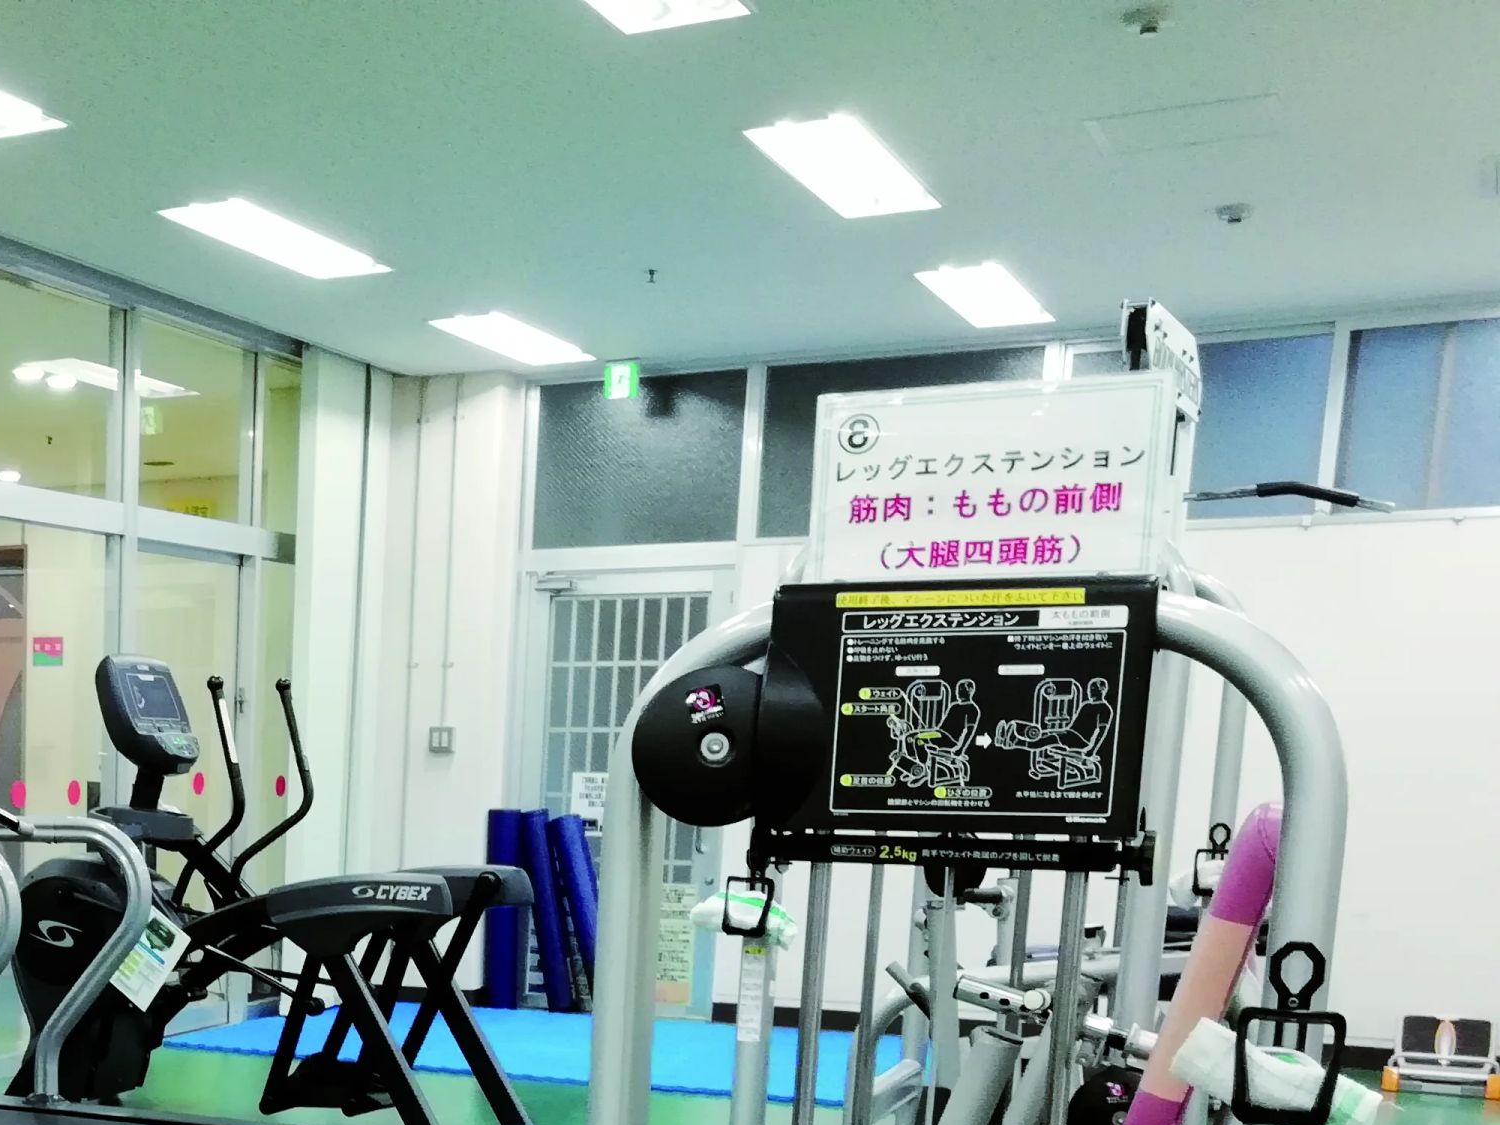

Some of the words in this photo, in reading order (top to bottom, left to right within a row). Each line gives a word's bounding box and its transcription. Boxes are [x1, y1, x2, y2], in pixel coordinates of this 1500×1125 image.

[836, 446, 1145, 482] レッグエクステンション
[862, 612, 1020, 630] レッグエクステンション
[879, 844, 917, 862] 2.5kg
[376, 885, 432, 901] CYBEX
